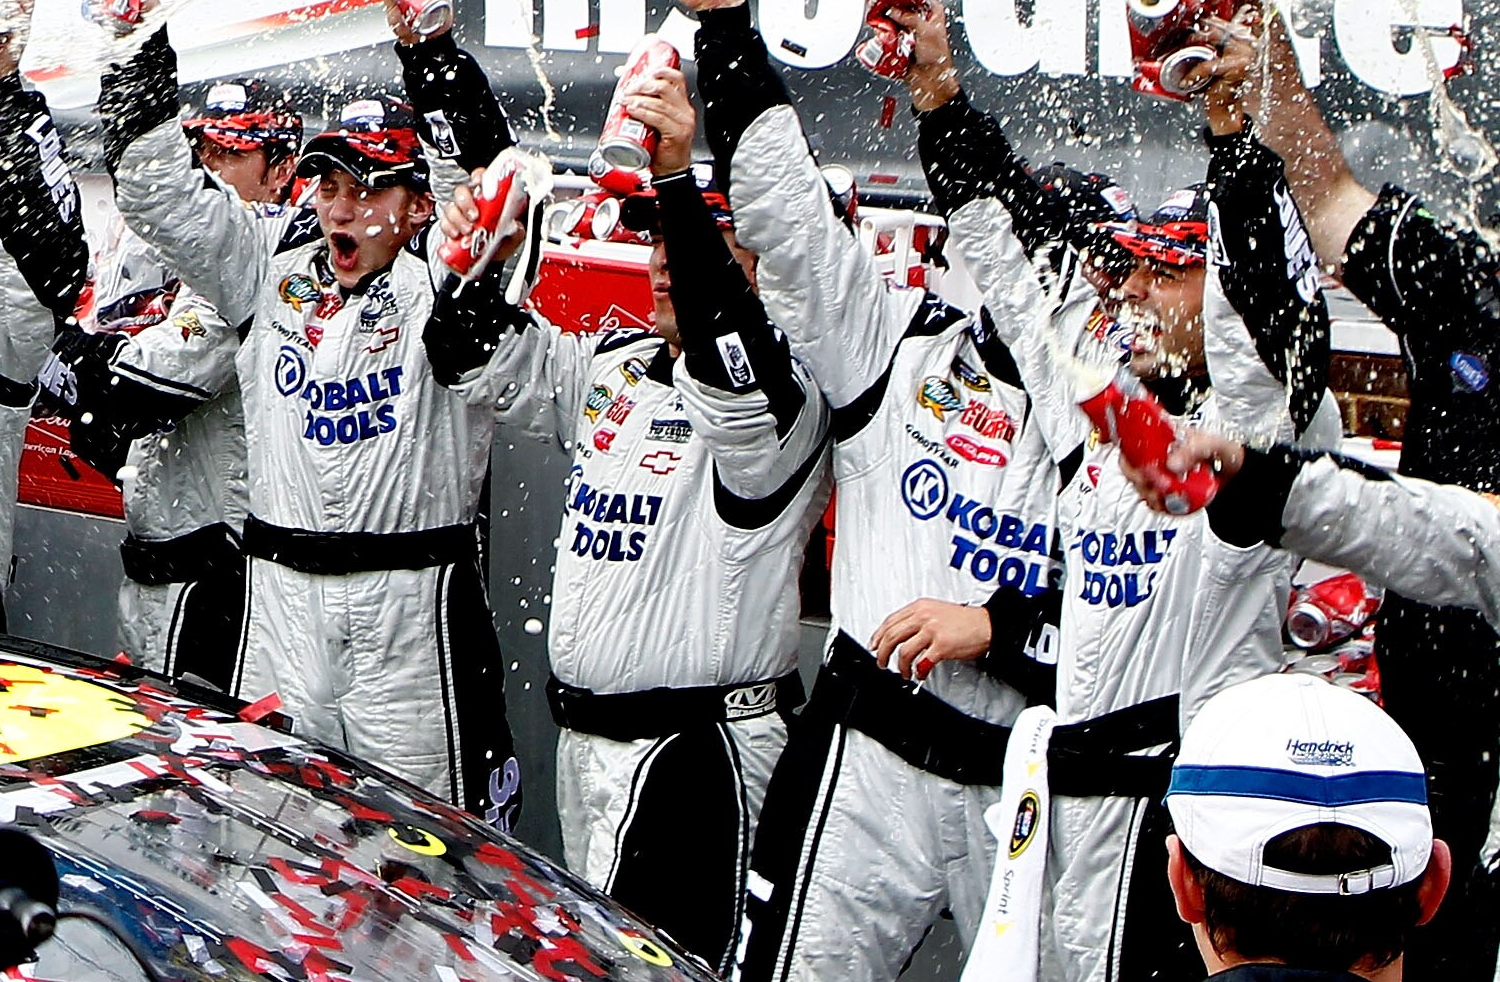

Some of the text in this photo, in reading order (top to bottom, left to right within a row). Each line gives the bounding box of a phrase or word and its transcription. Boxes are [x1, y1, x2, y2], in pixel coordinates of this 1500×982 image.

[24, 114, 77, 224] LOWE'S
[905, 423, 960, 469] GOODYEAR
[1285, 738, 1356, 756] Hendrick
[996, 867, 1016, 916] Sprint
